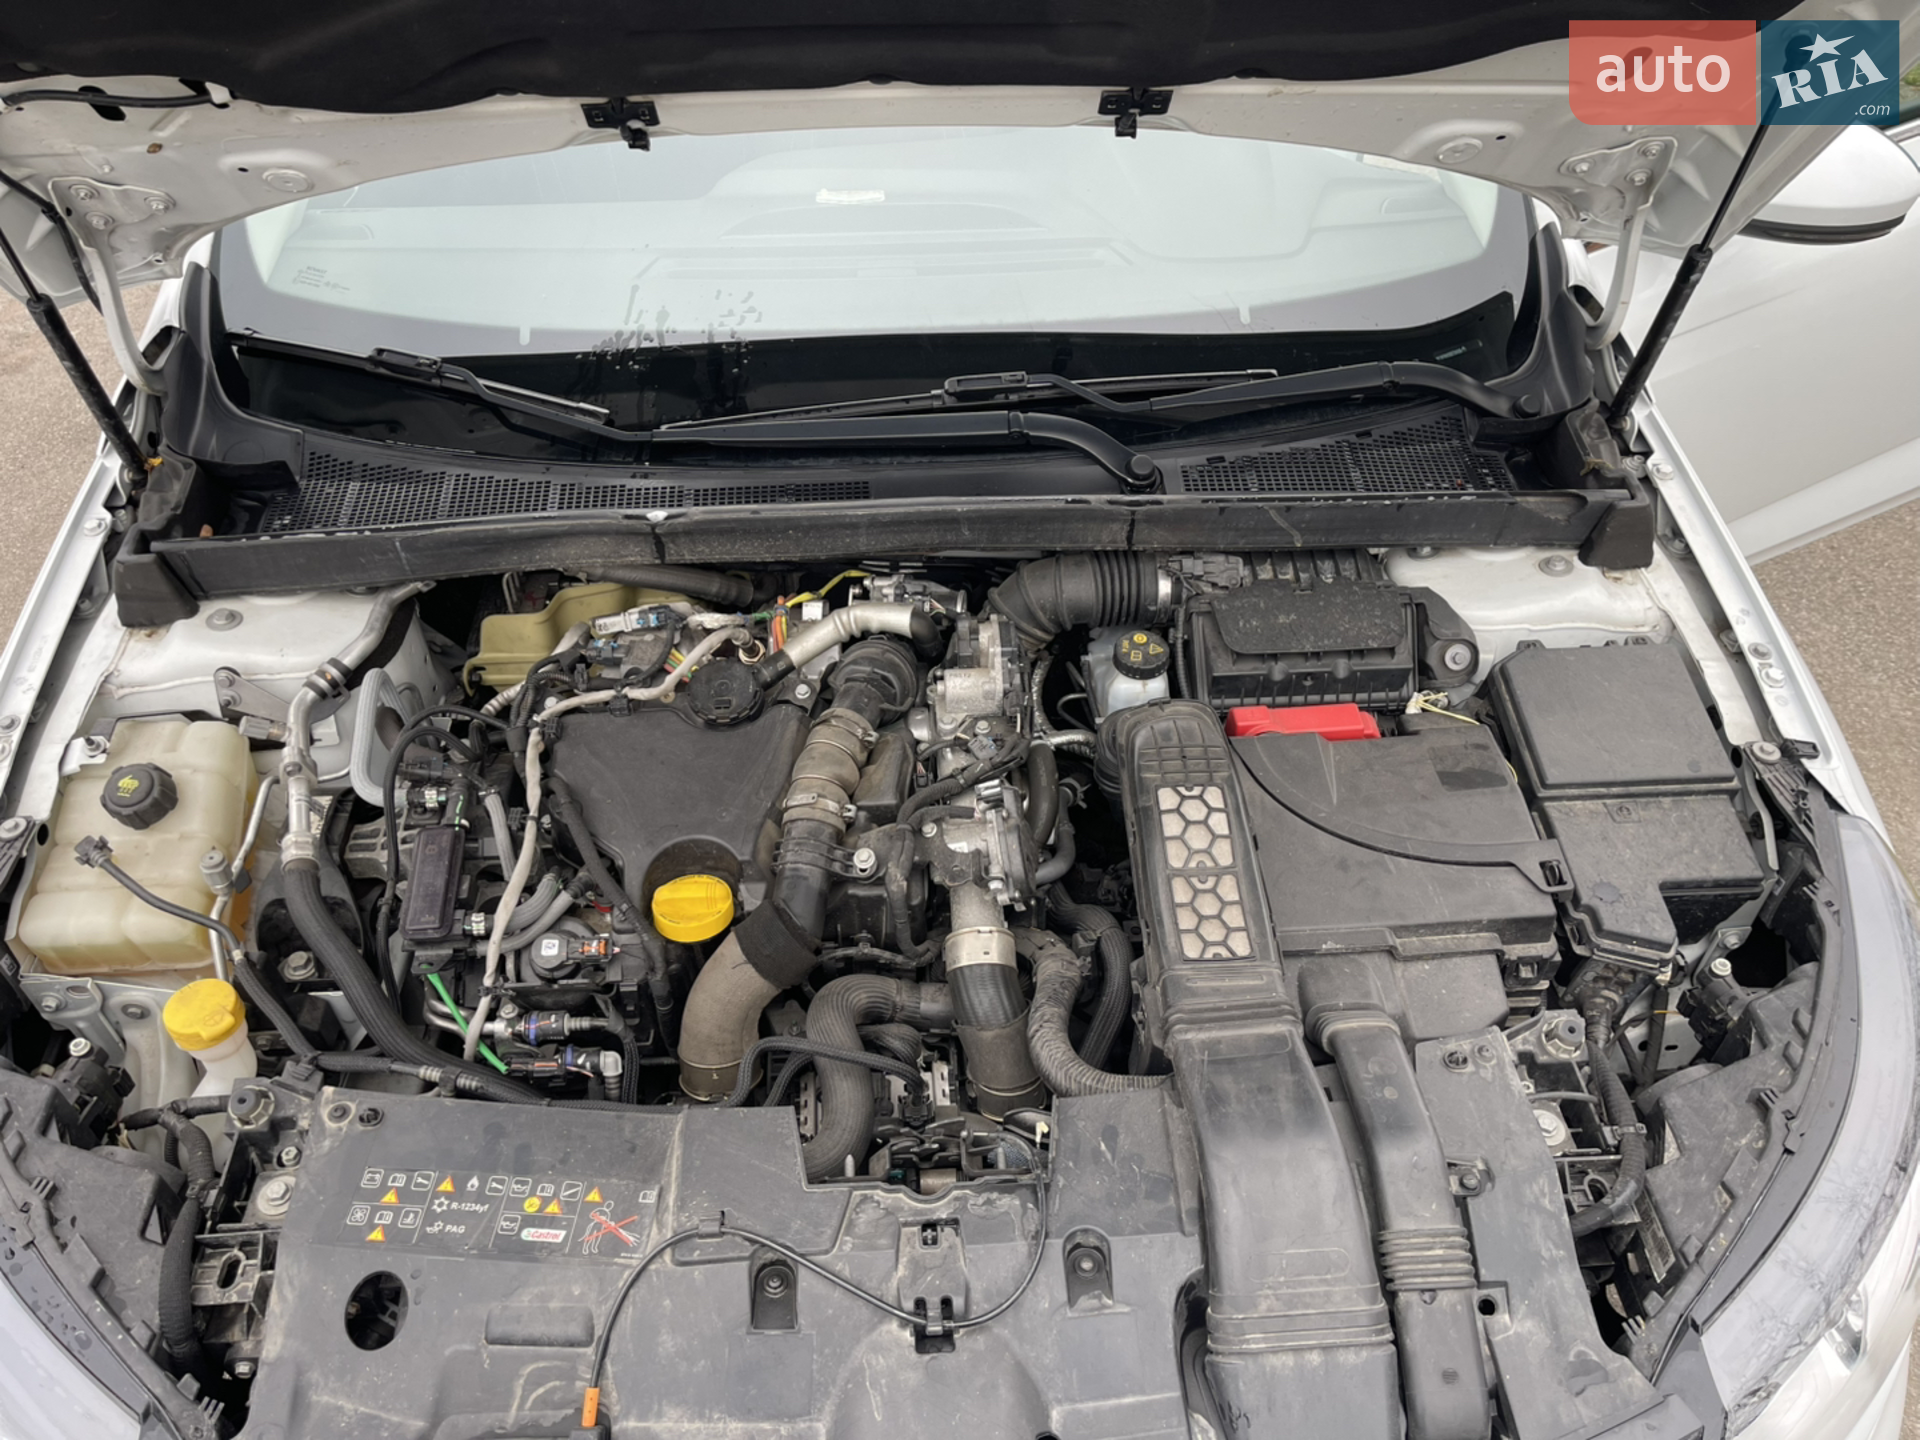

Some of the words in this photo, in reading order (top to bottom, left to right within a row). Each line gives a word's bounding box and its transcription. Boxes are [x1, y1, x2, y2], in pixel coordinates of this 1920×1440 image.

[450, 1201, 490, 1214] R-1234yf
[444, 1224, 466, 1234] PAG
[530, 1230, 562, 1241] Castrol
